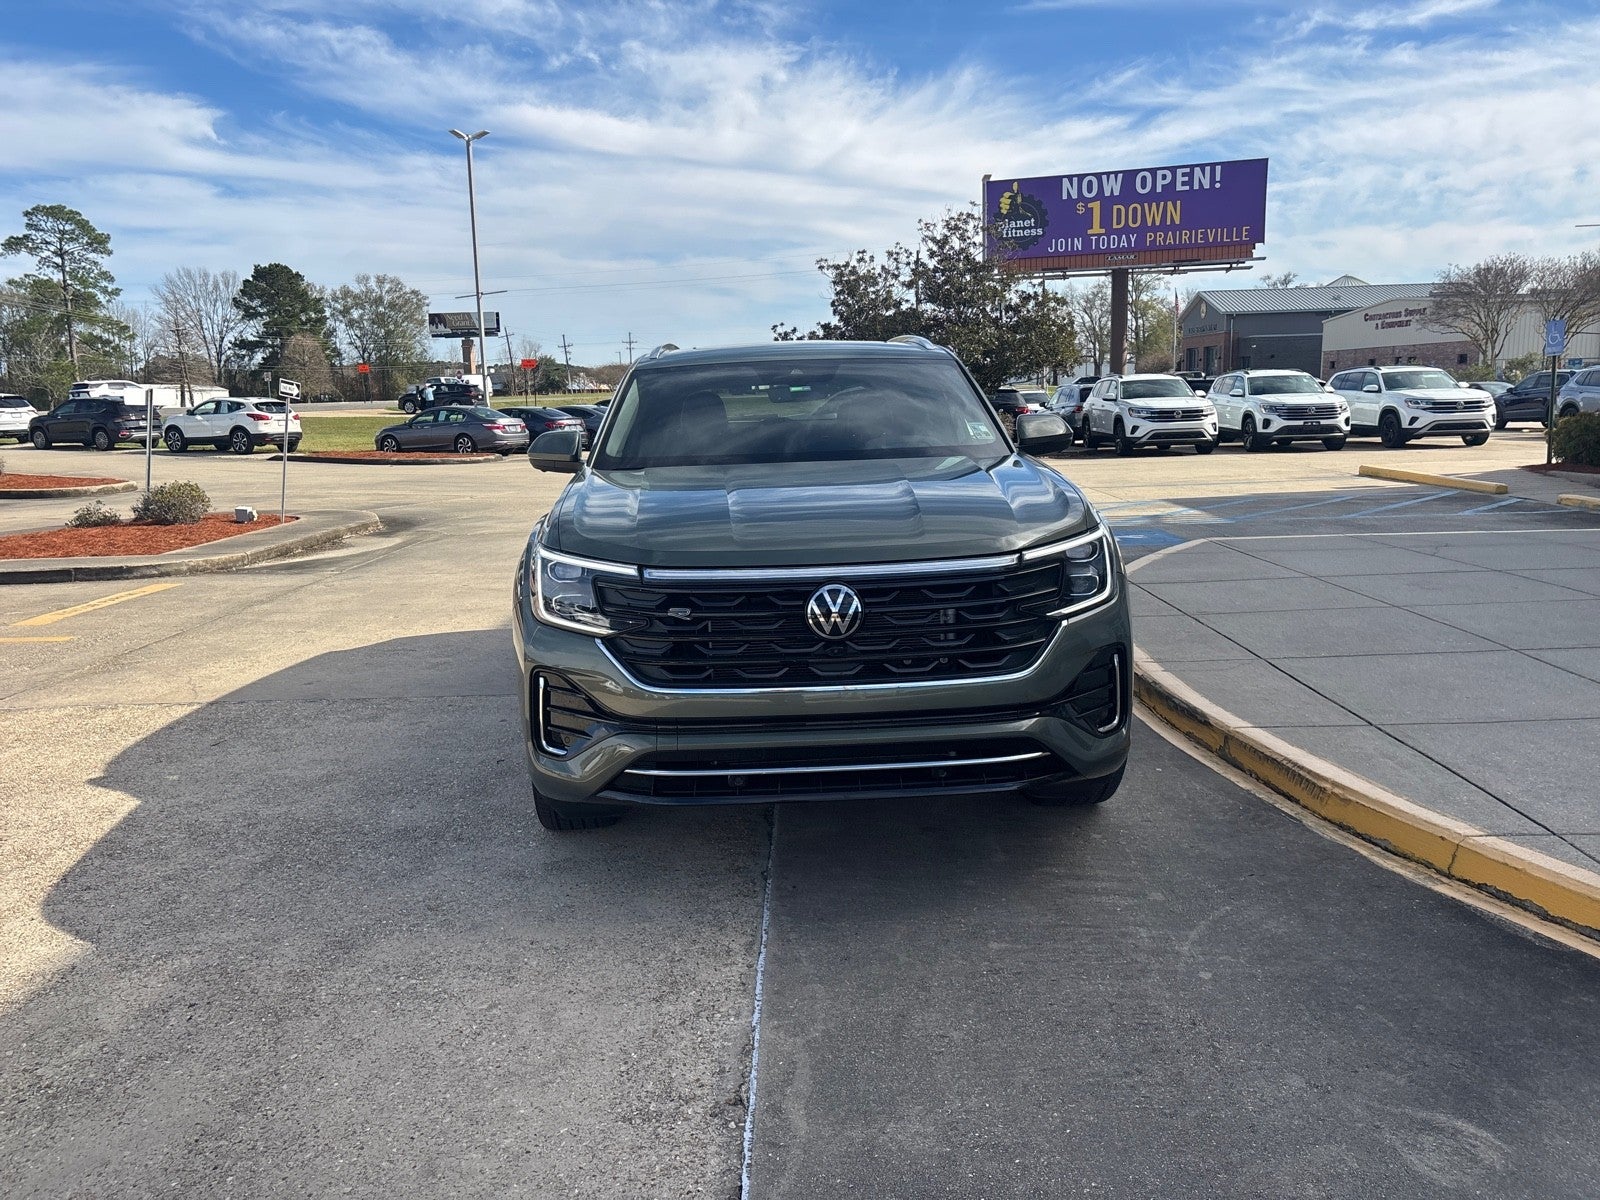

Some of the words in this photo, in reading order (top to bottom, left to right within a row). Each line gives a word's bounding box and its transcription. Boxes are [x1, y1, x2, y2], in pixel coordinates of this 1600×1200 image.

[1062, 173, 1123, 200] NOW
[1135, 165, 1222, 195] OPEN!
[1002, 227, 1043, 238] fitness
[1076, 200, 1106, 235] $1
[1112, 200, 1181, 229] DOWN
[1047, 237, 1082, 253] JOIN
[1090, 234, 1137, 250] TODAY
[1146, 226, 1251, 247] PRAIRIEVILLE
